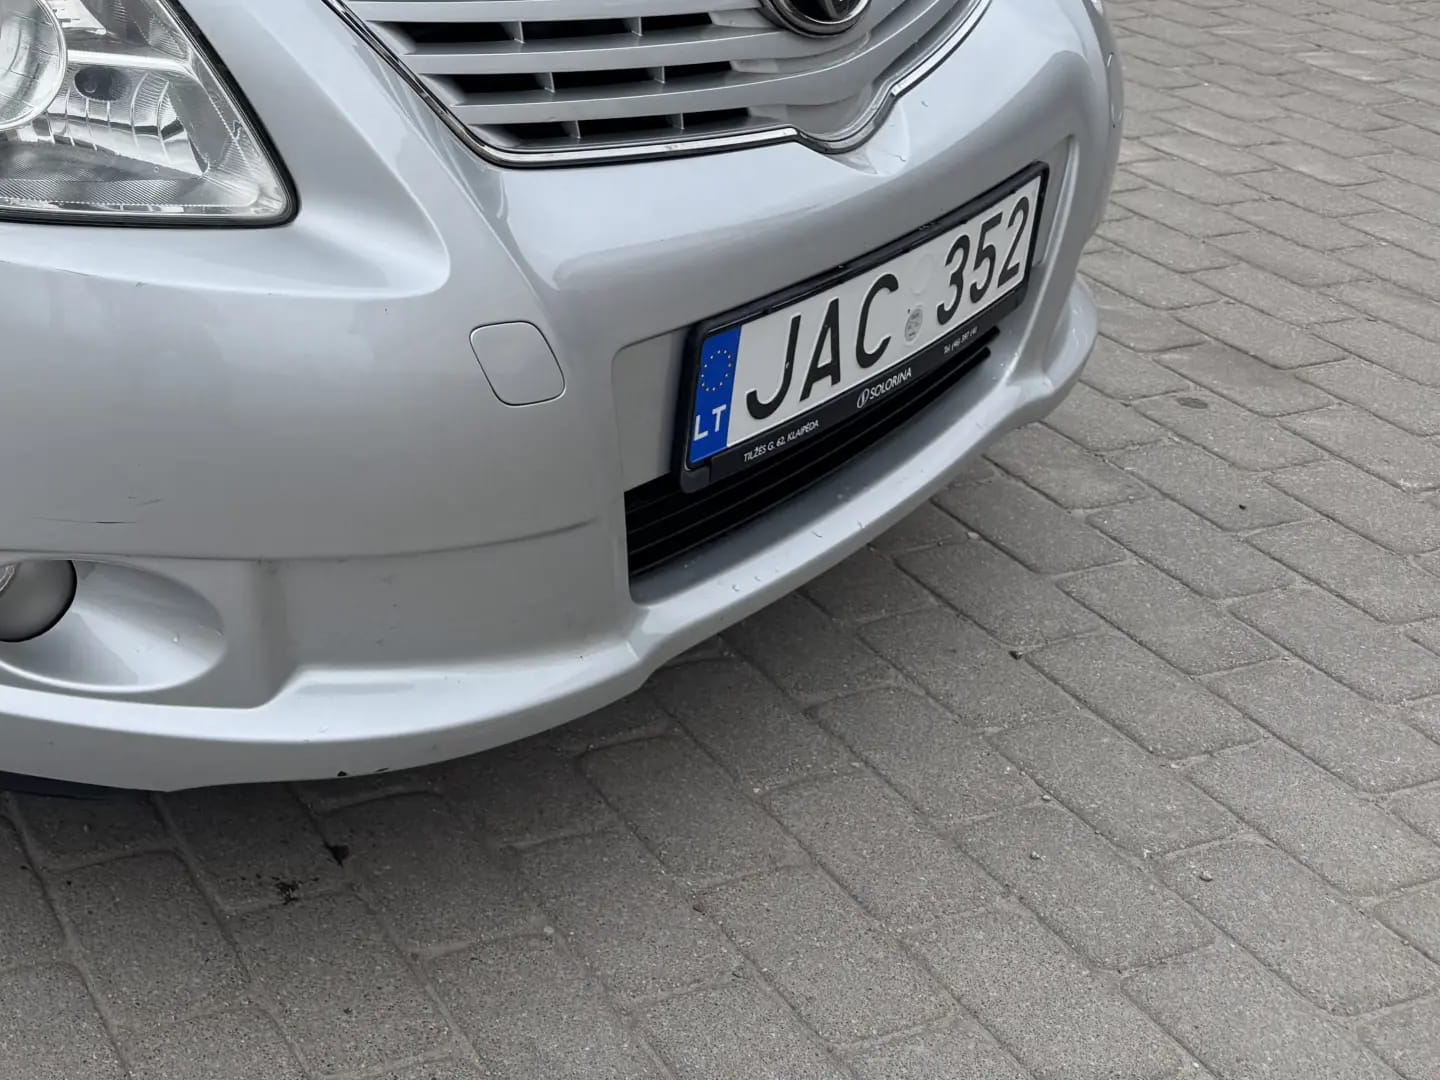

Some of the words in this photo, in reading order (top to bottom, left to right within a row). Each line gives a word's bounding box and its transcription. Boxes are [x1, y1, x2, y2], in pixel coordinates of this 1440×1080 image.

[746, 273, 899, 420] JAC
[936, 196, 1030, 325] 352
[870, 367, 912, 399] SOLORINA
[694, 404, 727, 441] LT
